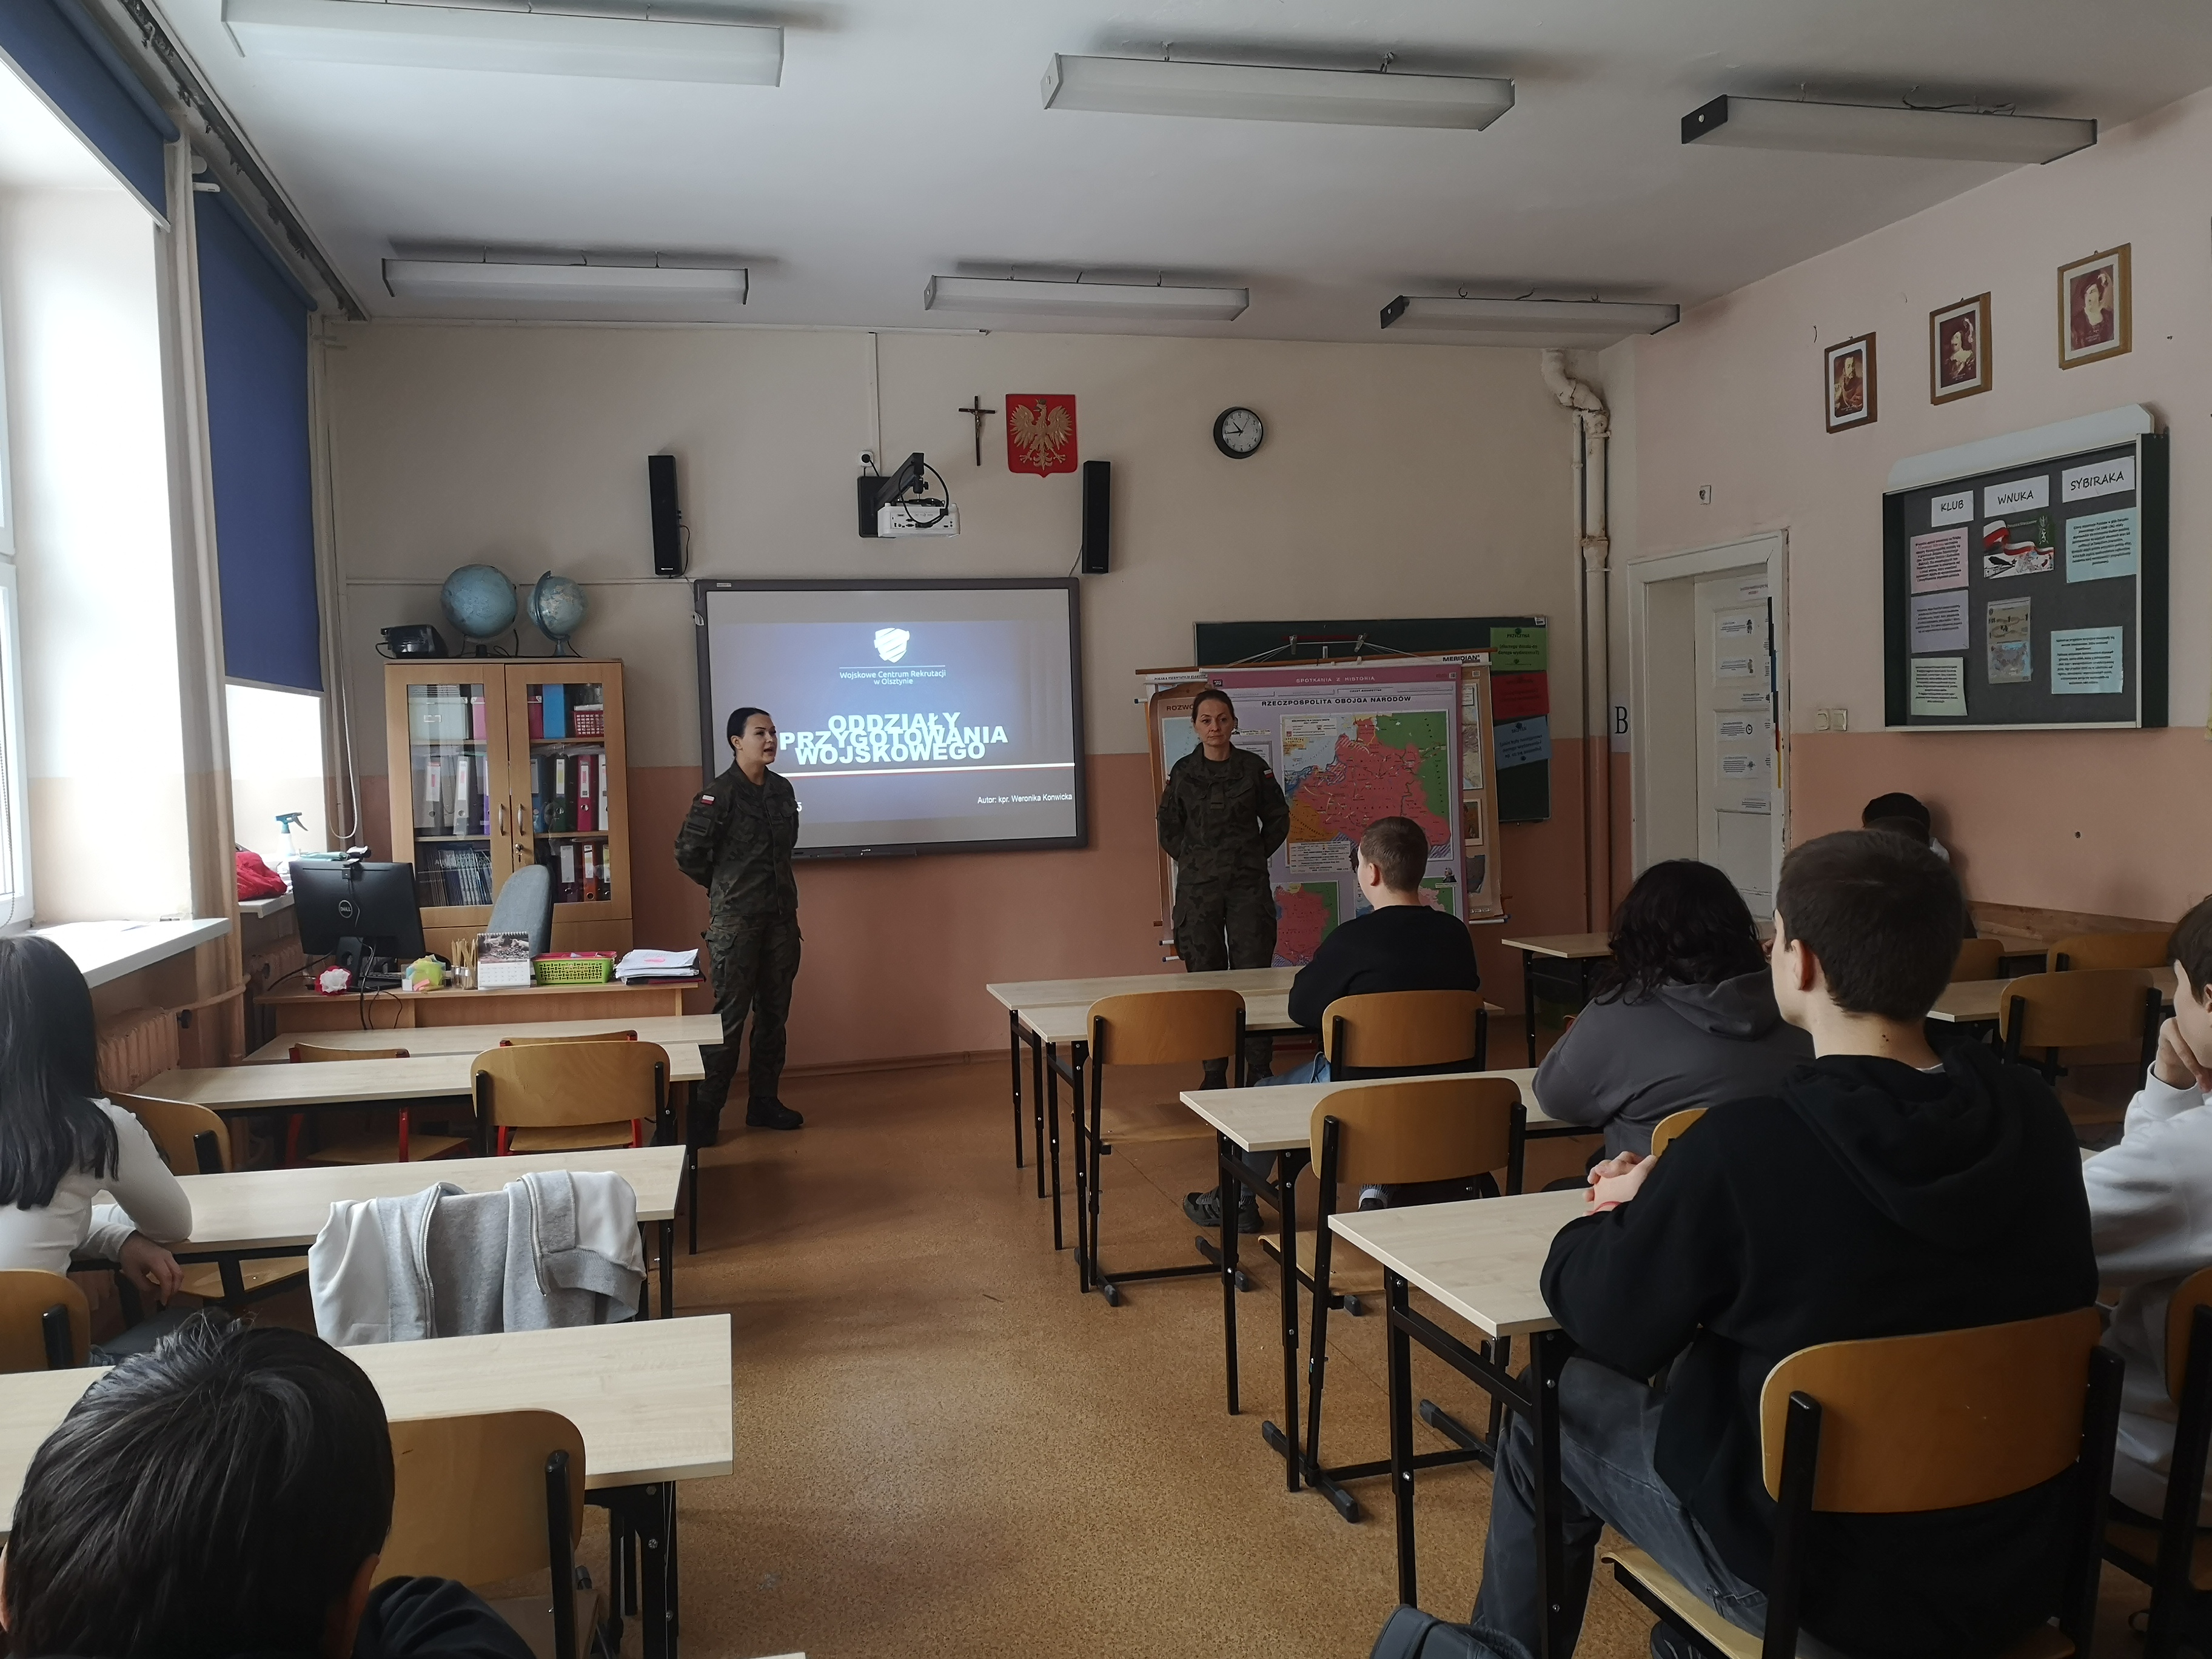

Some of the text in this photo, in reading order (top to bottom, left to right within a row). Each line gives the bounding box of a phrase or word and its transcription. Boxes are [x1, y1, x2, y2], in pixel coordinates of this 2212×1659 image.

[2070, 471, 2125, 491] SYBIRAKA
[1940, 500, 1964, 512] KLUB
[1997, 490, 2034, 505] WNUKA
[911, 669, 946, 678] Rekrutacji
[828, 712, 961, 733] ODDZIAŁY
[1614, 706, 1629, 734] B
[779, 726, 1008, 751] PRZYGOTOWANIA
[795, 742, 986, 765] WOJSKOWEGO
[998, 796, 1010, 804] kpr.
[1011, 794, 1041, 802] Weronika
[1042, 793, 1073, 801] Konwicka
